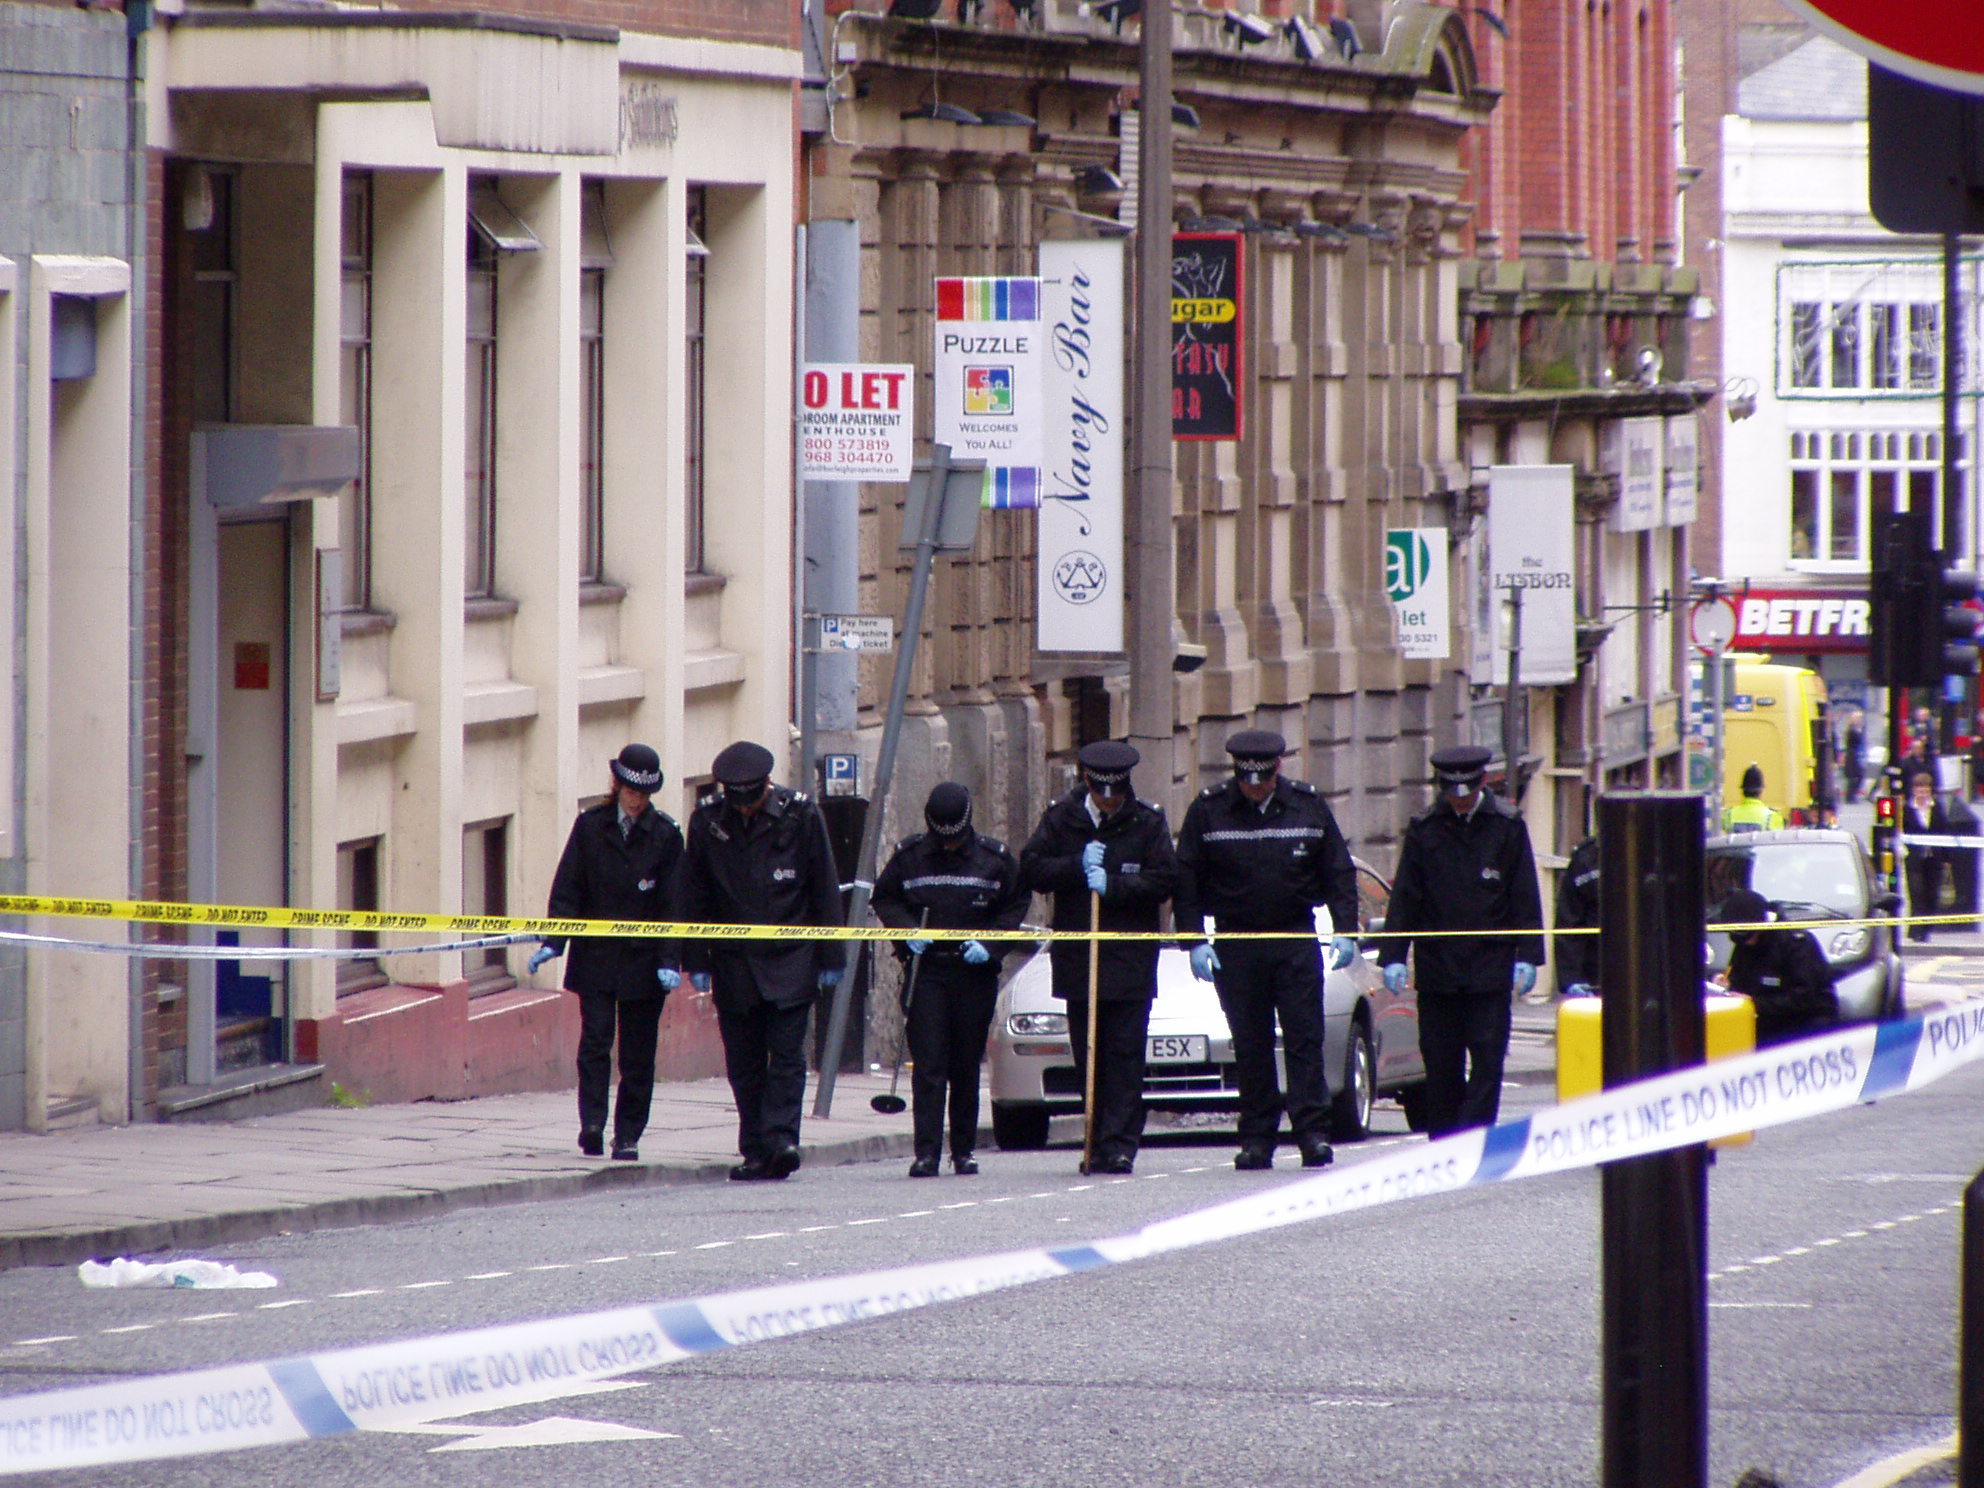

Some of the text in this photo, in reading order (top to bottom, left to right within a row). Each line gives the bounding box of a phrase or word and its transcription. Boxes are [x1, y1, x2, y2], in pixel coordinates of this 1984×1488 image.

[1051, 261, 1092, 379] Bar
[1172, 302, 1226, 321] ugar
[944, 334, 1029, 354] PUZZLE
[1176, 343, 1229, 375] TASY
[804, 371, 906, 410] O LET
[1173, 387, 1201, 420] AR
[840, 413, 901, 426] APARTMENT
[803, 427, 886, 437] ENTHOUSE
[805, 438, 890, 450] 800 573819
[805, 451, 893, 463] 968 304470
[1052, 384, 1109, 536] Navy
[1522, 555, 1543, 567] the
[841, 617, 856, 627] Pay
[859, 618, 878, 626] here
[1402, 610, 1426, 626] let
[1738, 599, 1872, 635] BETFR
[863, 640, 888, 648] ticket
[831, 757, 849, 778] P
[1152, 1038, 1191, 1057] ESX
[1534, 1045, 1857, 1162] POLICE LINE DO NOT CROSS
